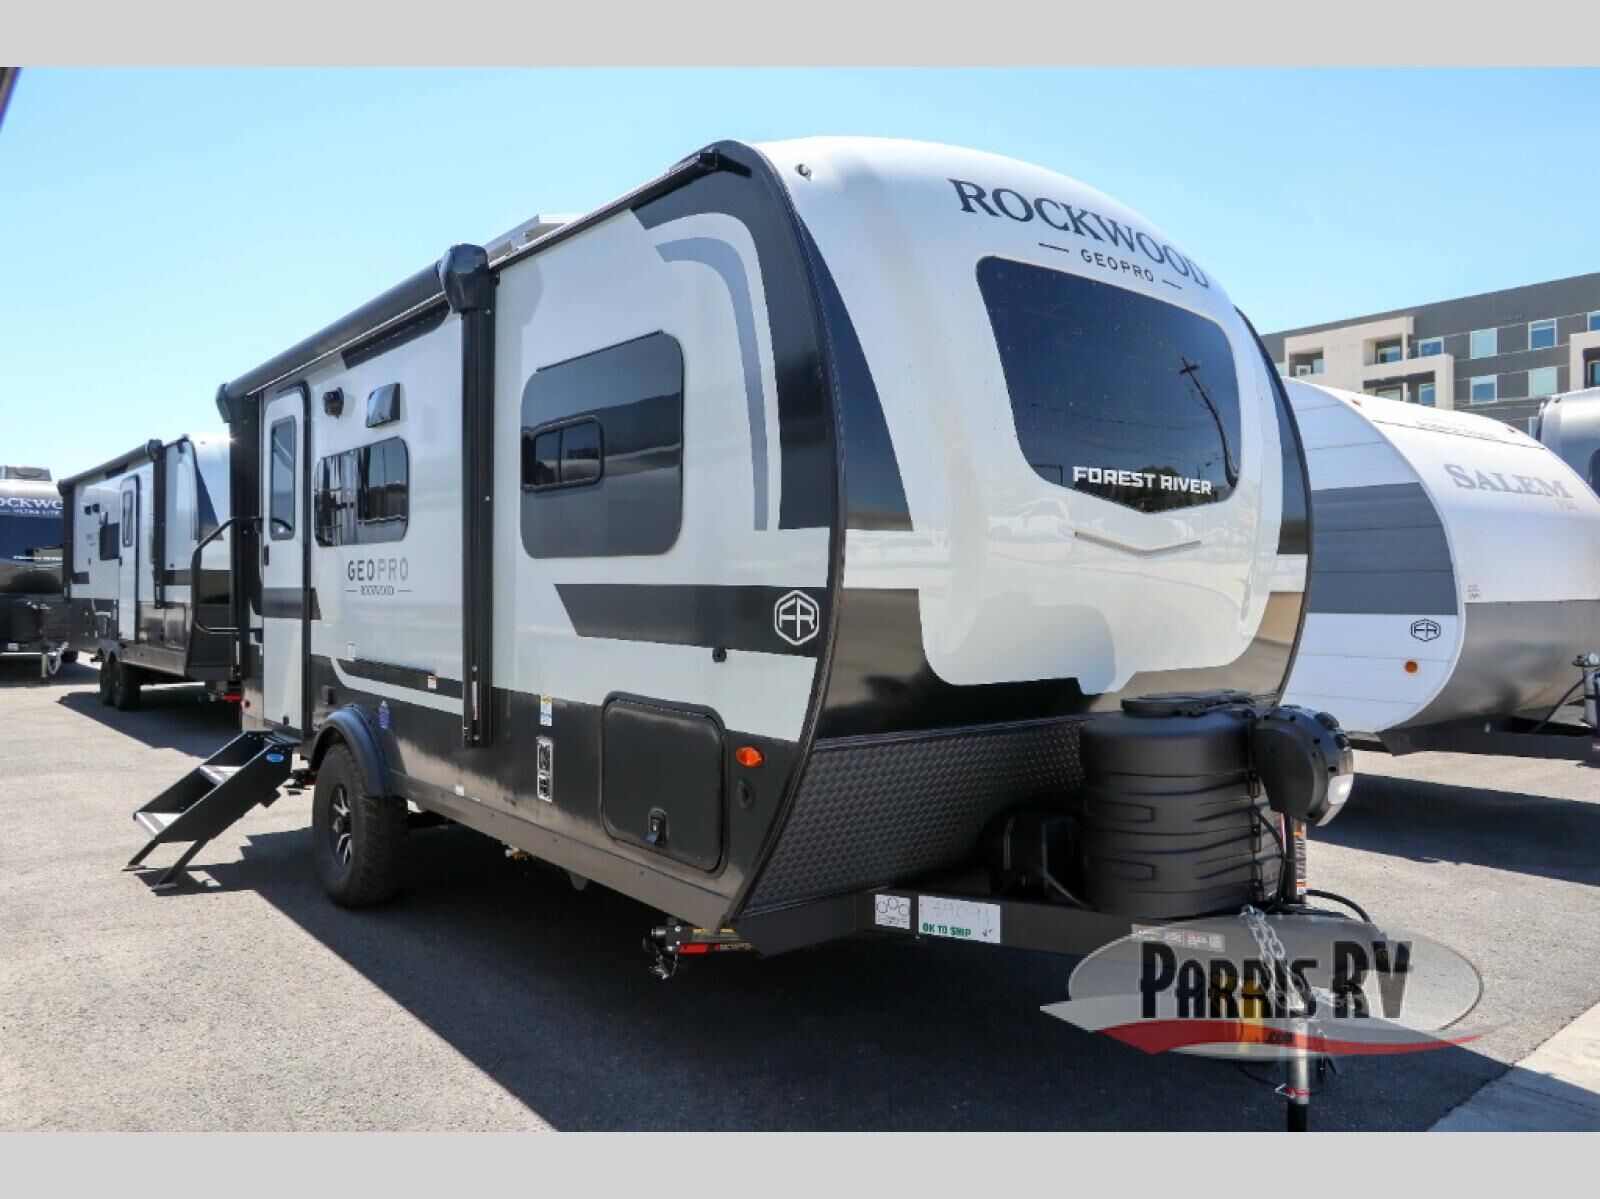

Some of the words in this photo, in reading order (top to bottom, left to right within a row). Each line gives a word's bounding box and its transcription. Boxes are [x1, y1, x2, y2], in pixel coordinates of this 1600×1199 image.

[947, 178, 1209, 289] ROCKWOOD
[1080, 249, 1154, 282] GEOPRO
[1072, 466, 1156, 488] FOREST
[1160, 474, 1212, 496] RIVER
[1443, 462, 1574, 499] SALEM
[347, 557, 409, 582] GEOPRO
[922, 922, 935, 933] OK
[937, 925, 948, 934] TO
[949, 926, 972, 937] SHIP
